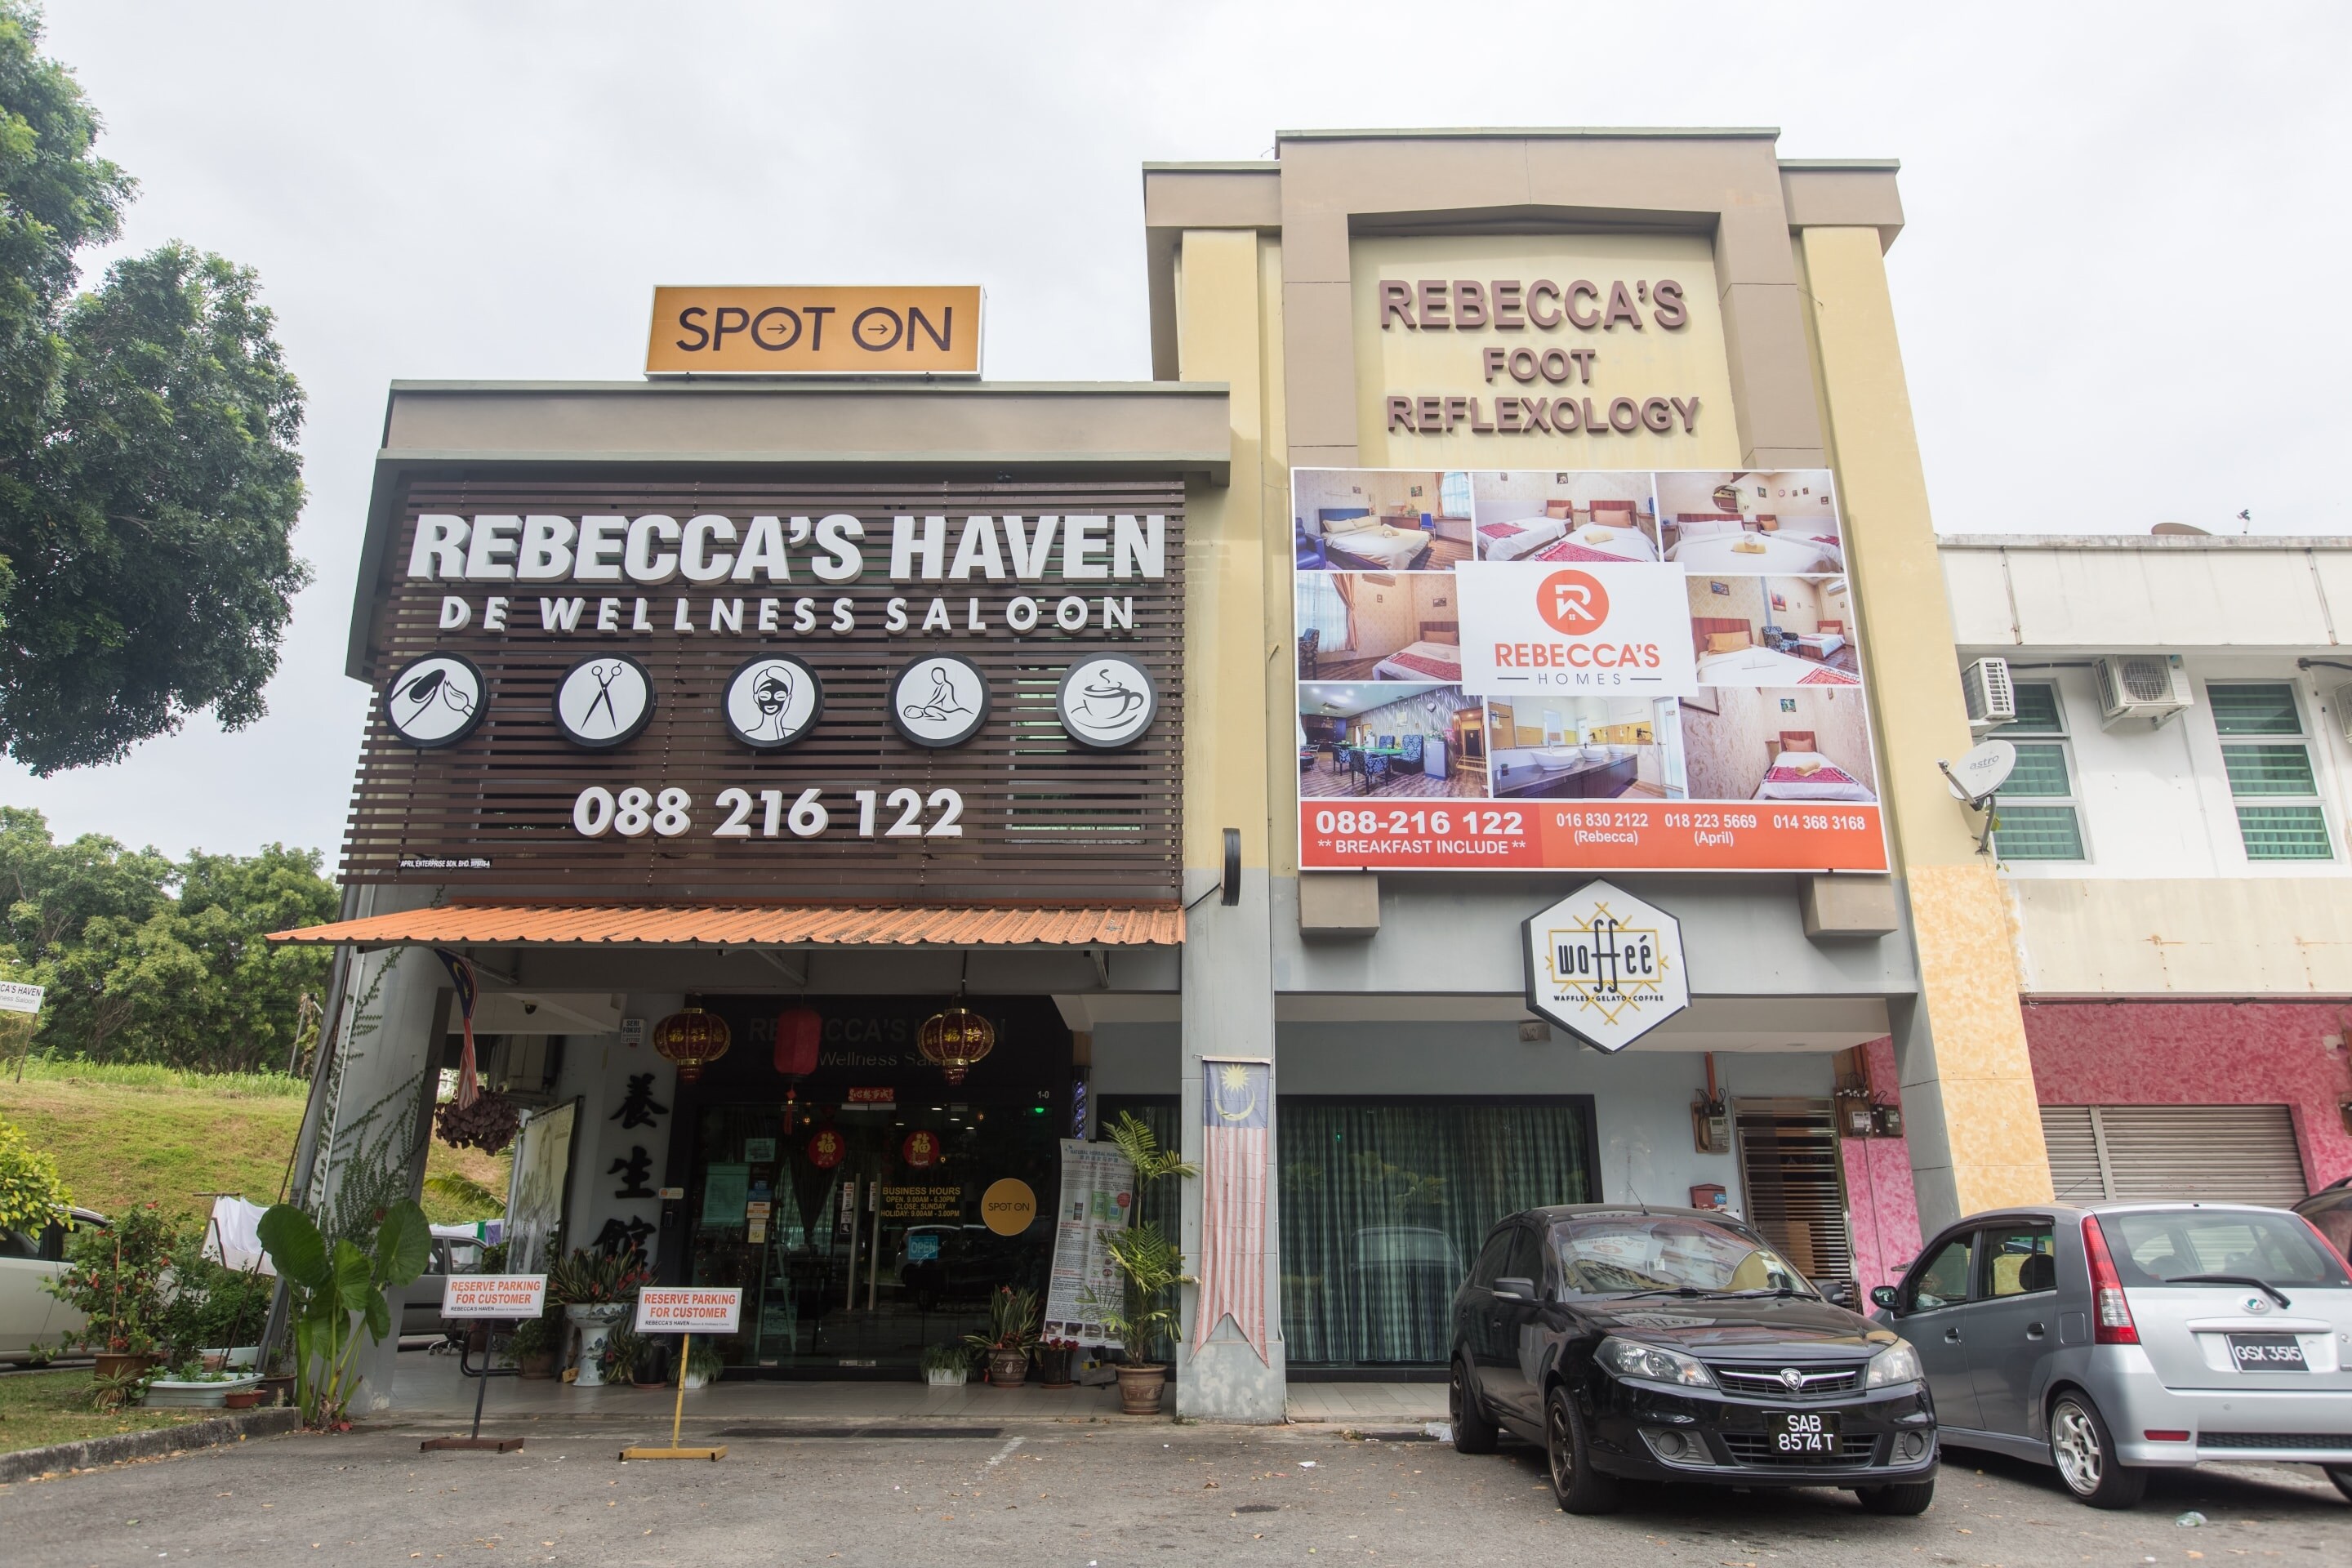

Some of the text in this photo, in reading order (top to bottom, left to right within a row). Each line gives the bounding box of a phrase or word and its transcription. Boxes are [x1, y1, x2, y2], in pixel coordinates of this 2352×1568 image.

[1379, 278, 1688, 330] REBECCA'S
[675, 306, 952, 352] SPOT ON
[1482, 346, 1597, 383] FOOT
[1386, 395, 1699, 433] REFLEXOLOGY
[408, 513, 1165, 586] REBECCA'S HAVEN
[439, 595, 1133, 635] DE WELLNESS SALOON
[1494, 643, 1660, 668] REBECCA'S
[1538, 673, 1621, 685] HOMES
[1969, 755, 1999, 770] astro
[572, 786, 964, 839] 088 216 122
[1556, 813, 1649, 827] 016 830 2122
[1316, 810, 1524, 835] 088-216 122
[1664, 813, 1757, 829] 018 223 5669
[1772, 814, 1866, 831] 014 368 3168
[1574, 830, 1638, 844] (Rebecca)
[1694, 831, 1734, 847] (April)
[1335, 840, 1432, 853] BREAKFAST
[1437, 840, 1509, 854] INCLUDE
[0, 984, 42, 996] CA'S HAVEN
[15, 996, 36, 1004] Saloon
[750, 1018, 906, 1043] RCCA'S
[819, 1050, 898, 1067] Wellness
[1037, 1090, 1049, 1098] 1-0
[817, 1132, 837, 1154] 福
[911, 1132, 932, 1154] 福
[882, 1187, 961, 1196] BUSINESS HOURS
[988, 1202, 1030, 1211] SPOT ON
[911, 1241, 936, 1254] OPEN
[451, 1281, 541, 1291] RESERVE PARKING
[456, 1294, 532, 1304] FOR CUSTOMER
[644, 1294, 736, 1305] RESERVE PARKING
[650, 1307, 727, 1318] FOR CUSTOMER
[2234, 1345, 2266, 1361] GSX
[1787, 1414, 1822, 1432] SAB
